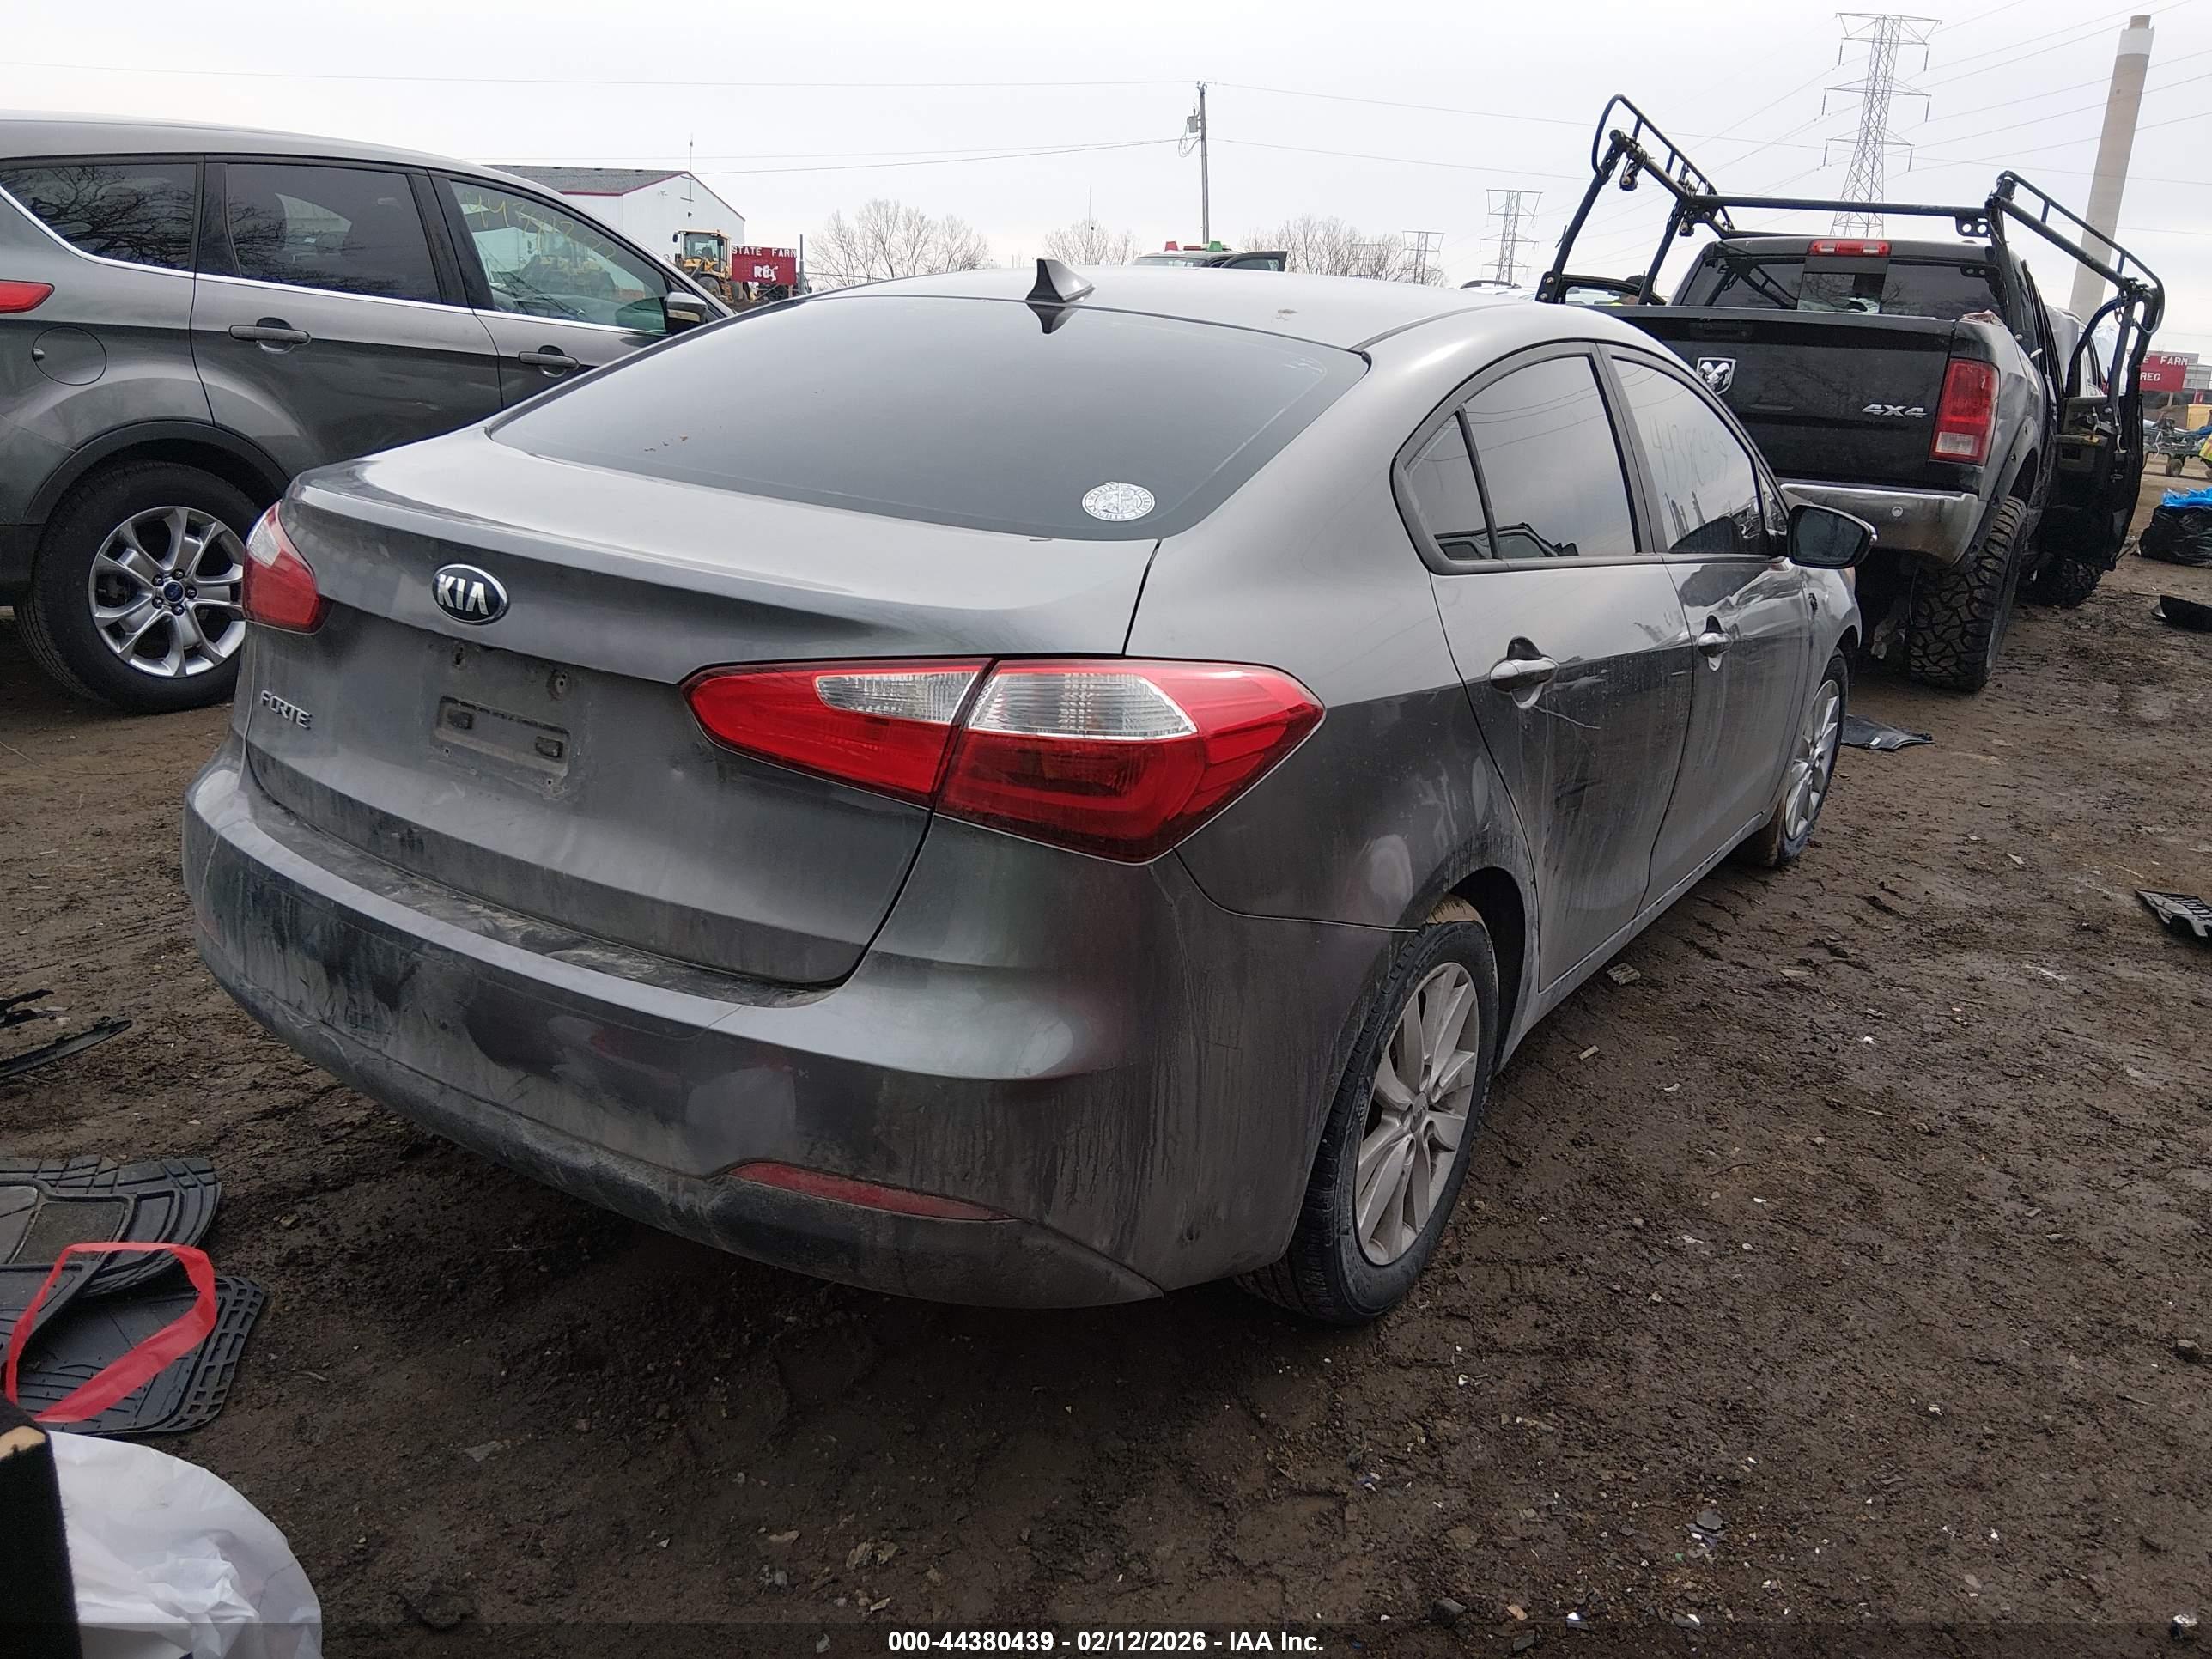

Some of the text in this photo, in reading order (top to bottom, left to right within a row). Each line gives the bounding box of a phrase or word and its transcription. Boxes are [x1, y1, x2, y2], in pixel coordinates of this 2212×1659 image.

[732, 246, 763, 256] STATE
[2160, 356, 2188, 366] FARM
[2140, 372, 2161, 381] REG
[1861, 404, 1928, 418] 4X4
[437, 573, 489, 616] KIA
[260, 690, 310, 730] FORTE
